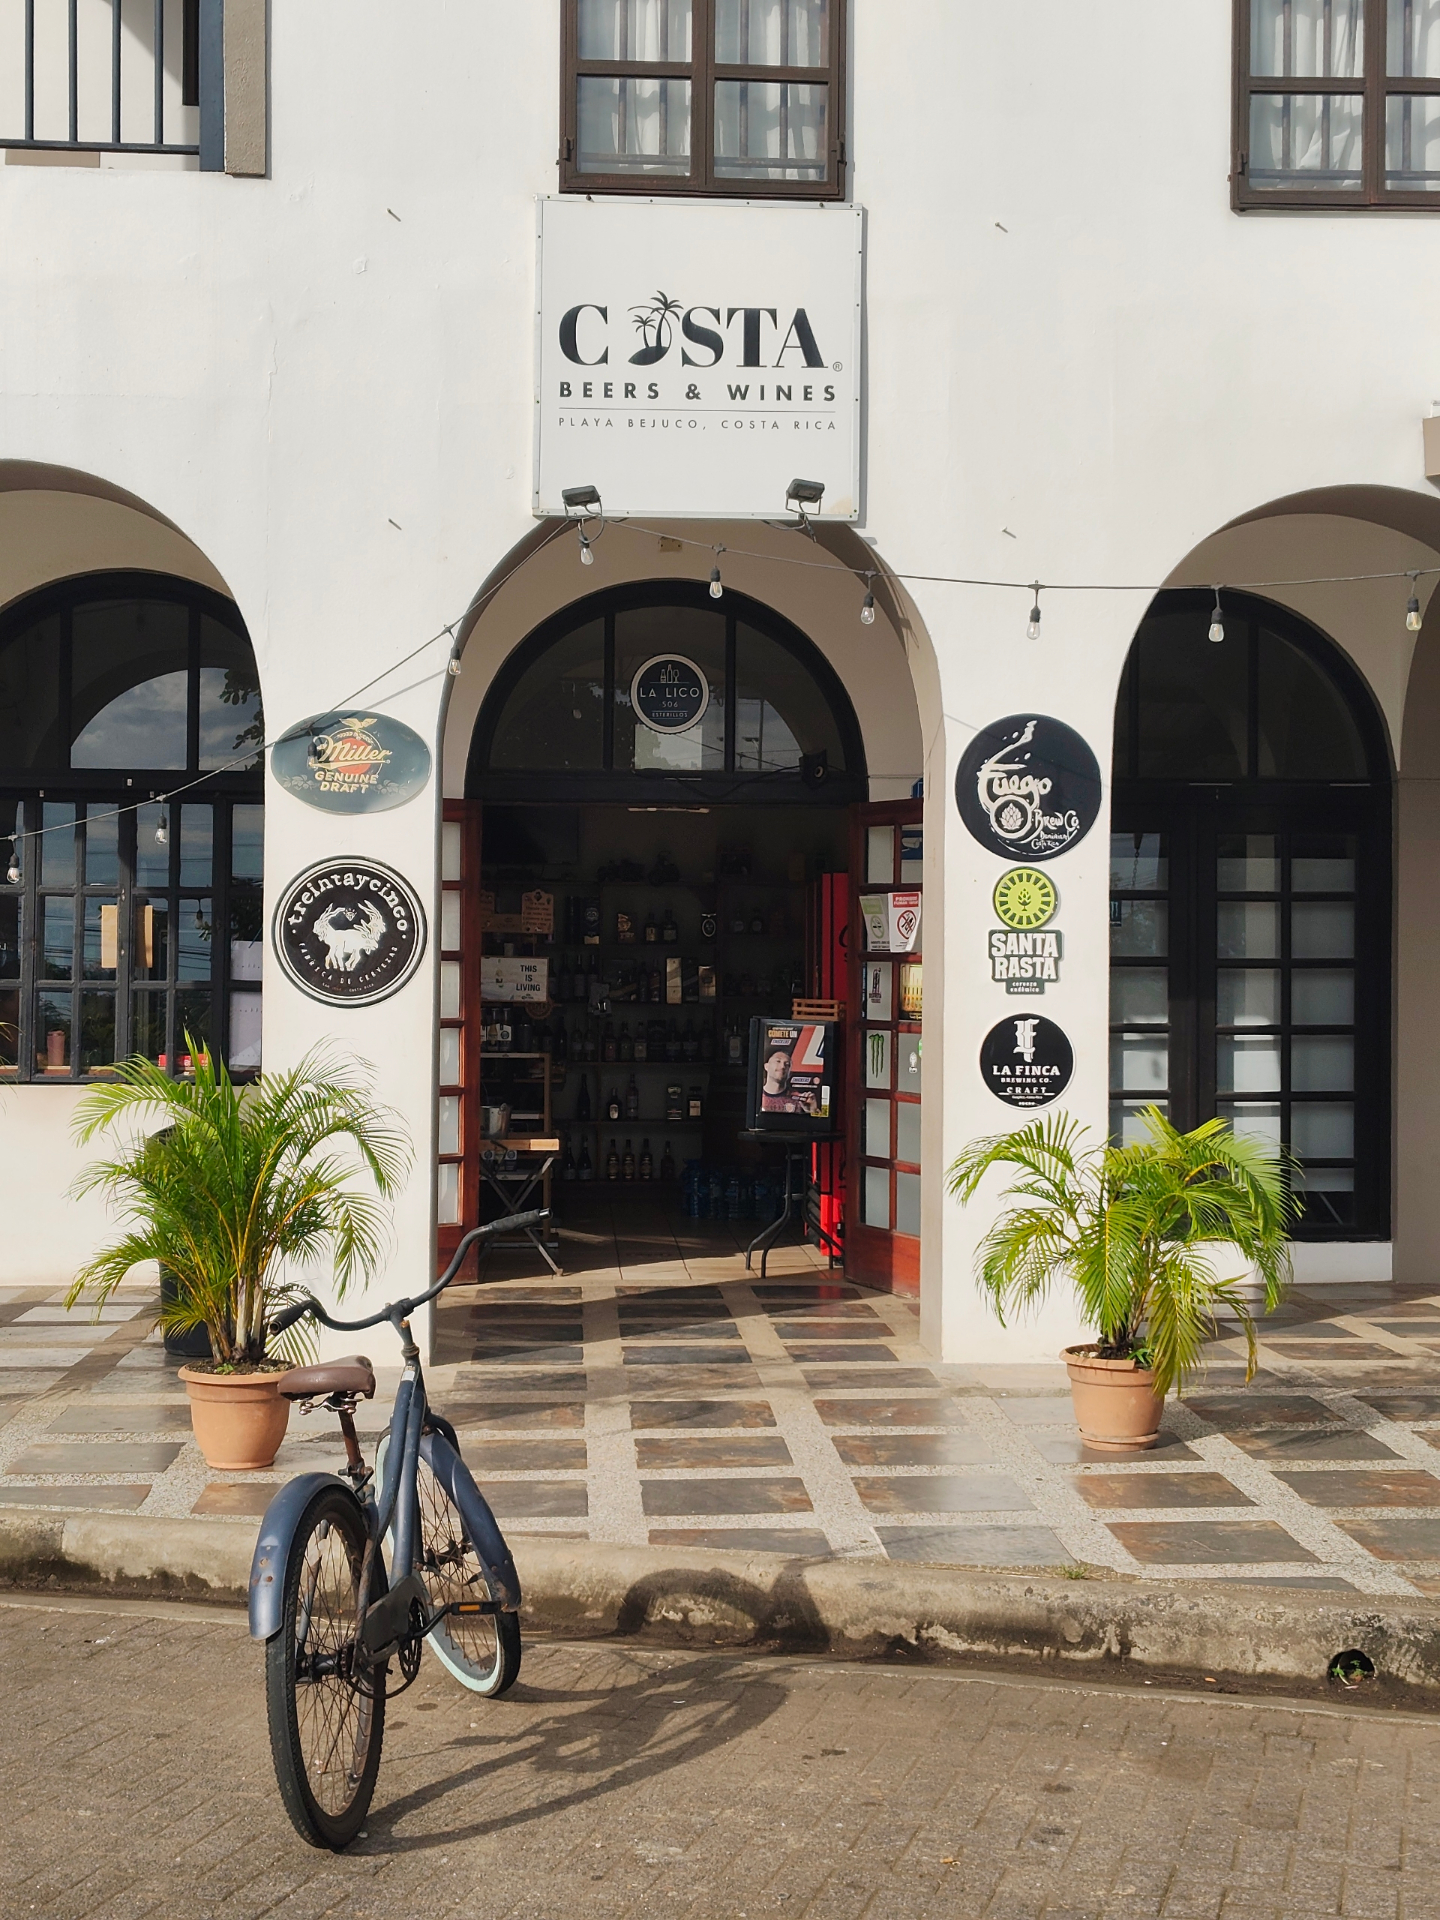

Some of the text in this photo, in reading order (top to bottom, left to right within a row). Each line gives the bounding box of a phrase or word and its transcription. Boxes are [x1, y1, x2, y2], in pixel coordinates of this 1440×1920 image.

[559, 381, 836, 402] BEERS & WINES
[559, 417, 836, 430] PLAYA BEJUCO, COSTA RICA
[640, 687, 700, 698] LA LICO
[312, 735, 393, 763] Miller
[314, 771, 378, 785] GENUINE
[320, 782, 369, 794] DRAFT
[288, 872, 408, 931] treintaycinco
[991, 933, 1059, 957] SANTA
[520, 964, 538, 973] THIS
[994, 957, 1057, 979] RASTA
[525, 974, 533, 982] IS
[515, 983, 541, 992] LIVING
[992, 1065, 1061, 1076] LA FINCA
[1006, 1086, 1047, 1094] CRAFT
